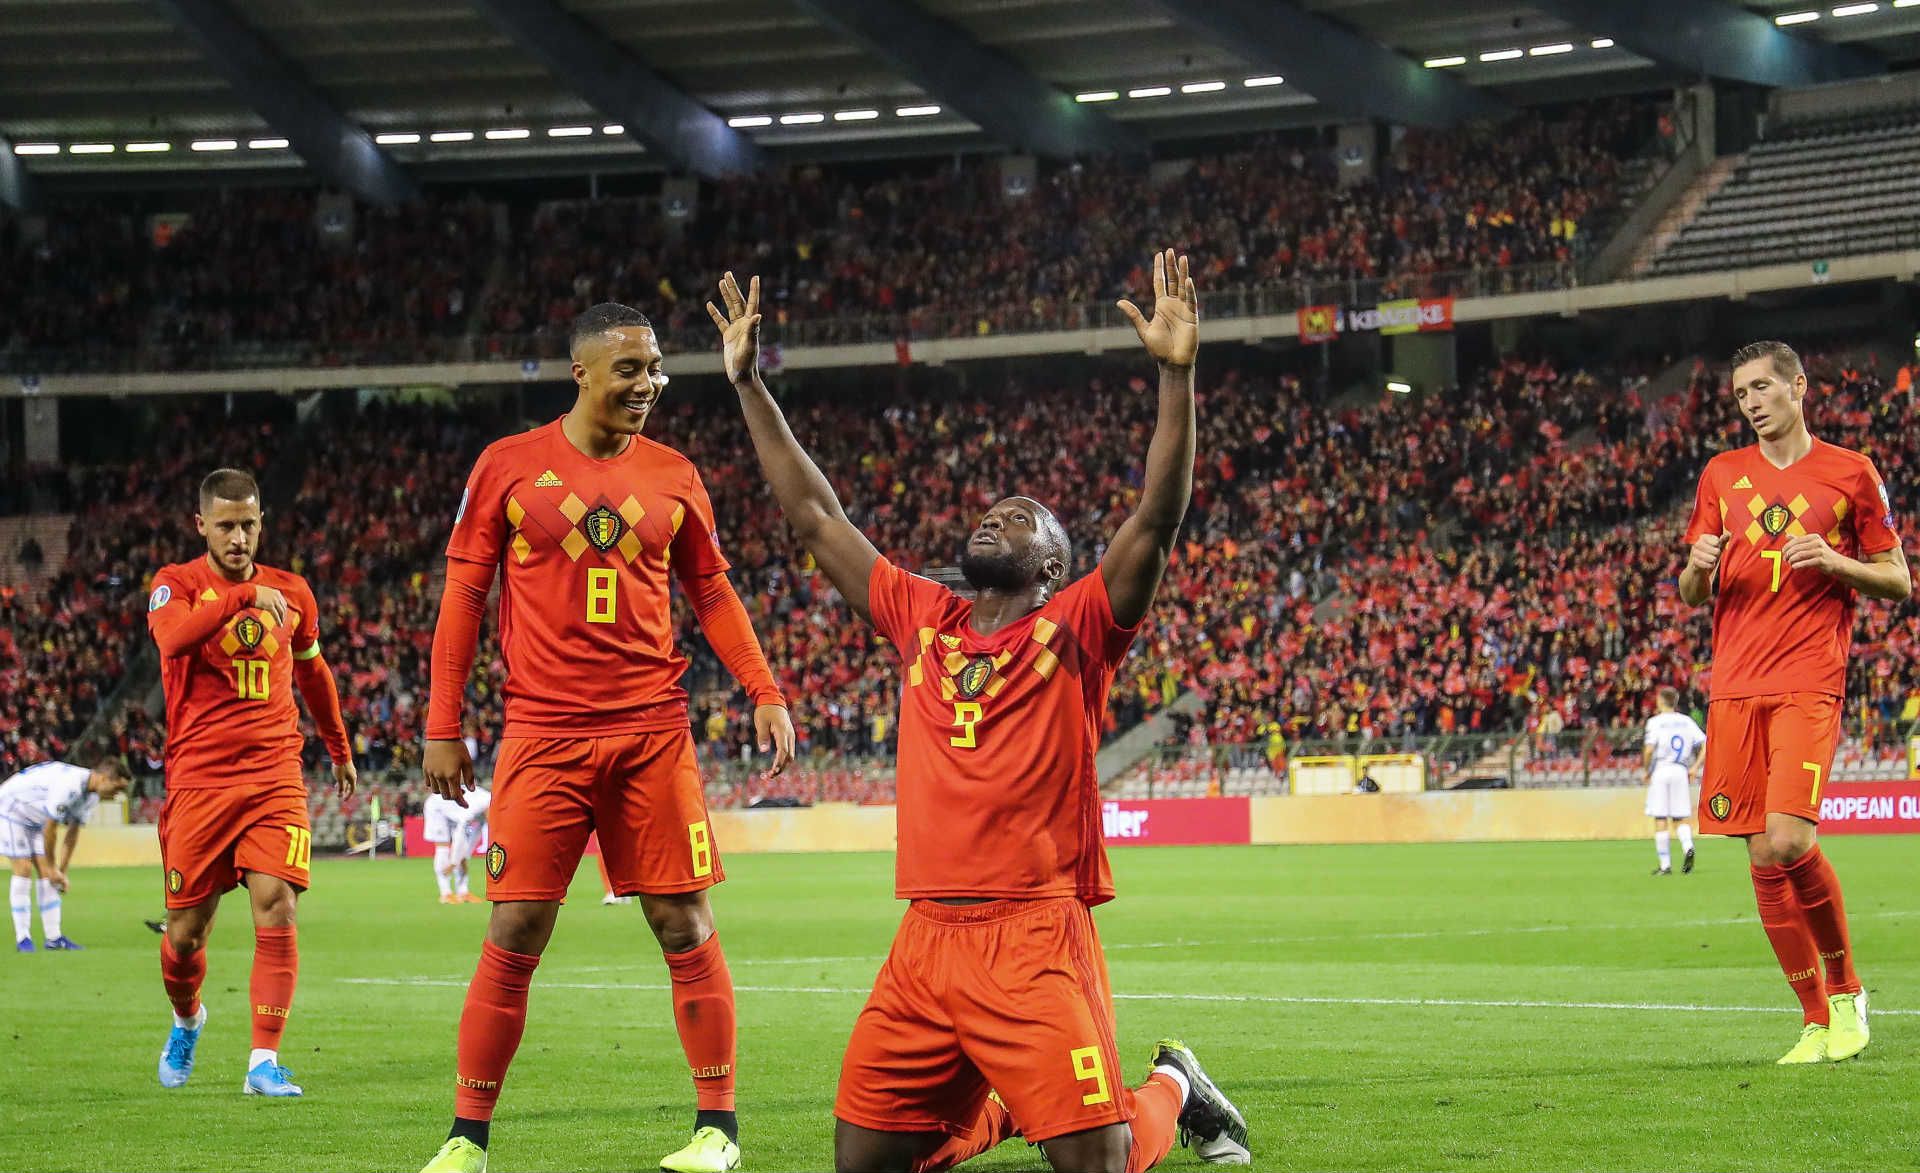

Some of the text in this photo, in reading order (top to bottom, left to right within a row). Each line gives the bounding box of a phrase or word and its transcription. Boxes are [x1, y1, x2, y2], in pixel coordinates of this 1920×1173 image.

[534, 480, 563, 488] adidas
[1760, 550, 1782, 592] 7
[587, 568, 617, 623] 8
[232, 659, 270, 700] 10
[950, 702, 983, 748] 9
[1670, 735, 1684, 763] 9
[1802, 762, 1821, 805] 7
[1102, 802, 1149, 838] iler
[1819, 797, 1894, 820] ROPEAN
[285, 825, 311, 872] 10
[688, 821, 712, 878] 8
[1071, 1045, 1110, 1105] 9
